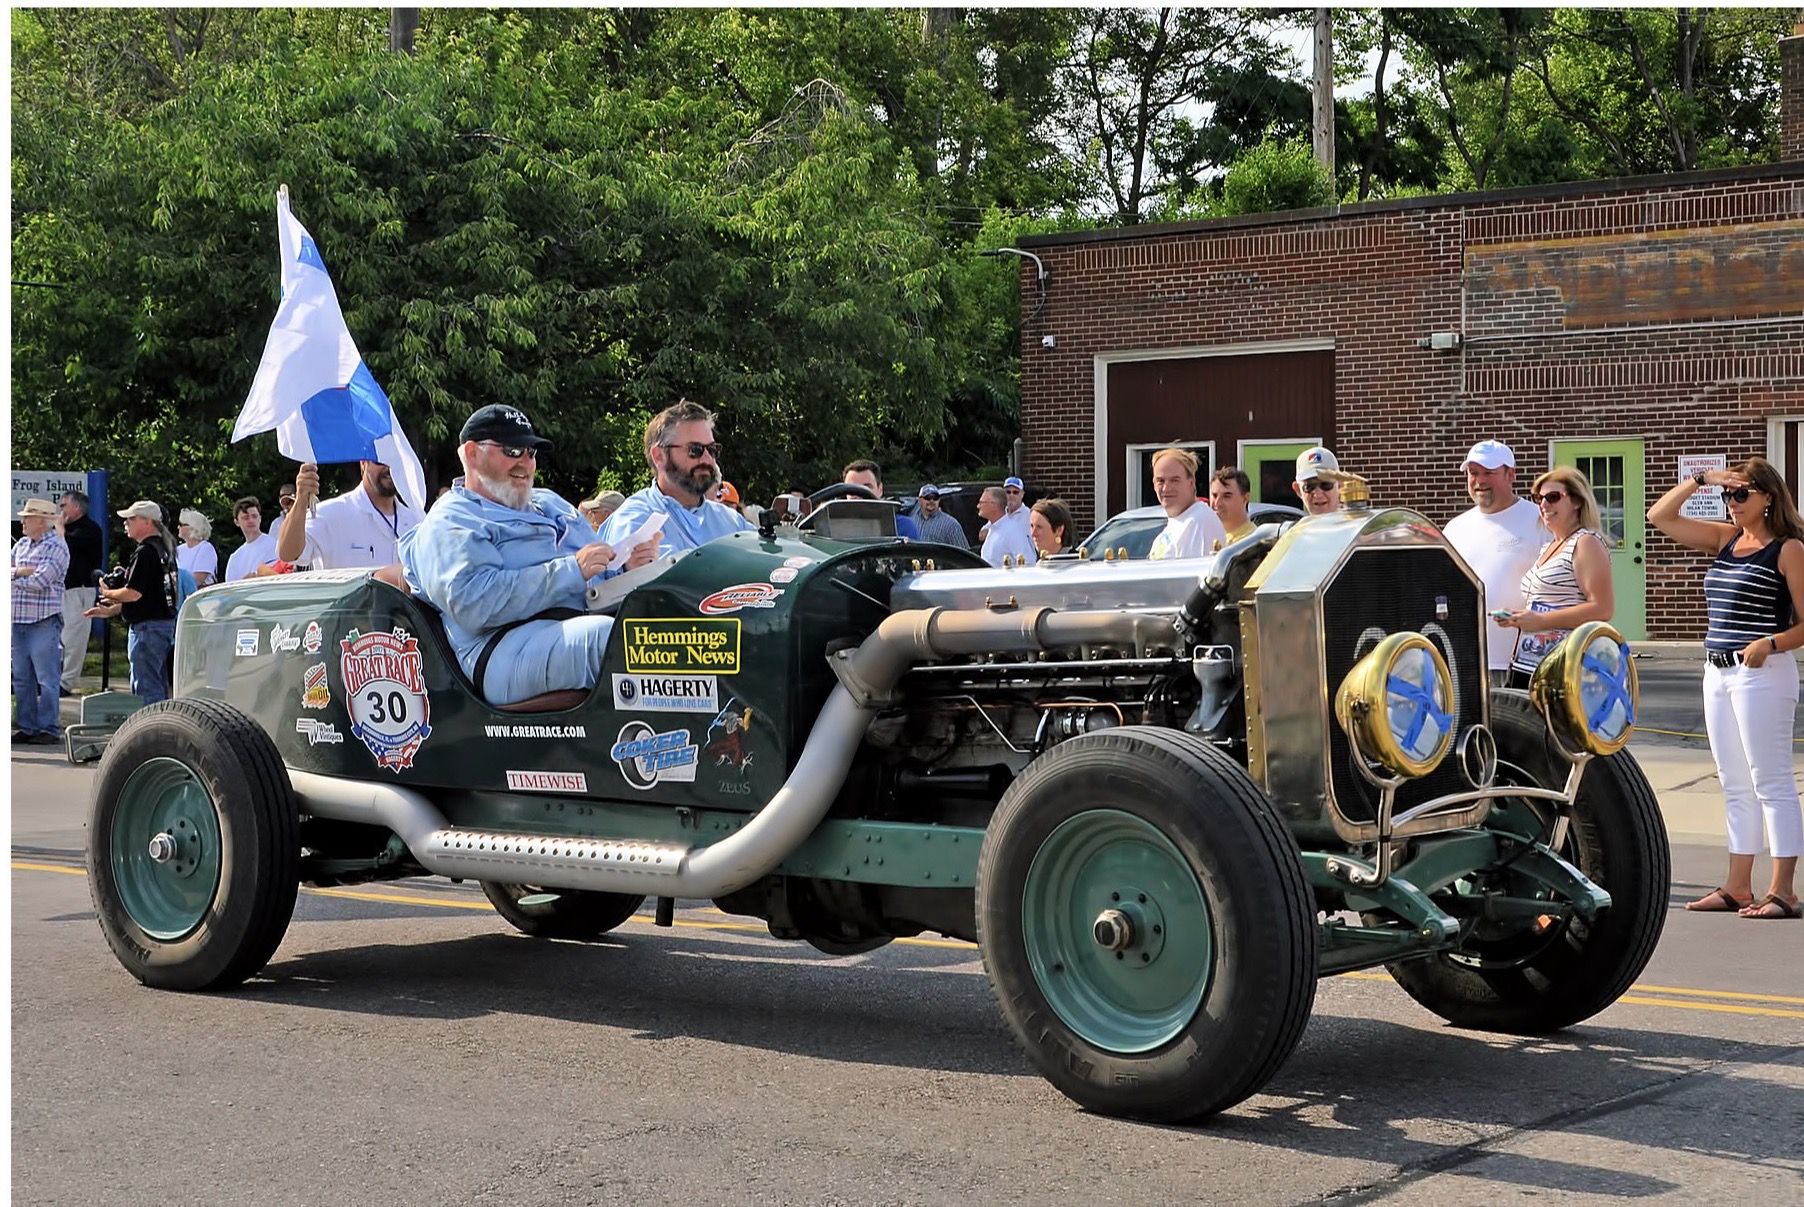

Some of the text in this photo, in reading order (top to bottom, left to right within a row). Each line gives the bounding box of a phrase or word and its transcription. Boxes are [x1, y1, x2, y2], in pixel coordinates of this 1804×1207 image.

[12, 479, 83, 492] Frog Island
[634, 626, 728, 650] Hemmings
[629, 645, 736, 665] Motor News
[343, 653, 384, 695] GREAT
[384, 653, 423, 693] RACE
[641, 679, 713, 697] HAGERTY
[367, 691, 408, 724] 30
[485, 725, 586, 738] WWW.GREATRACE.COM
[612, 731, 688, 761] COKER
[642, 747, 696, 773] TIRE
[509, 773, 585, 790] TIMEWISE
